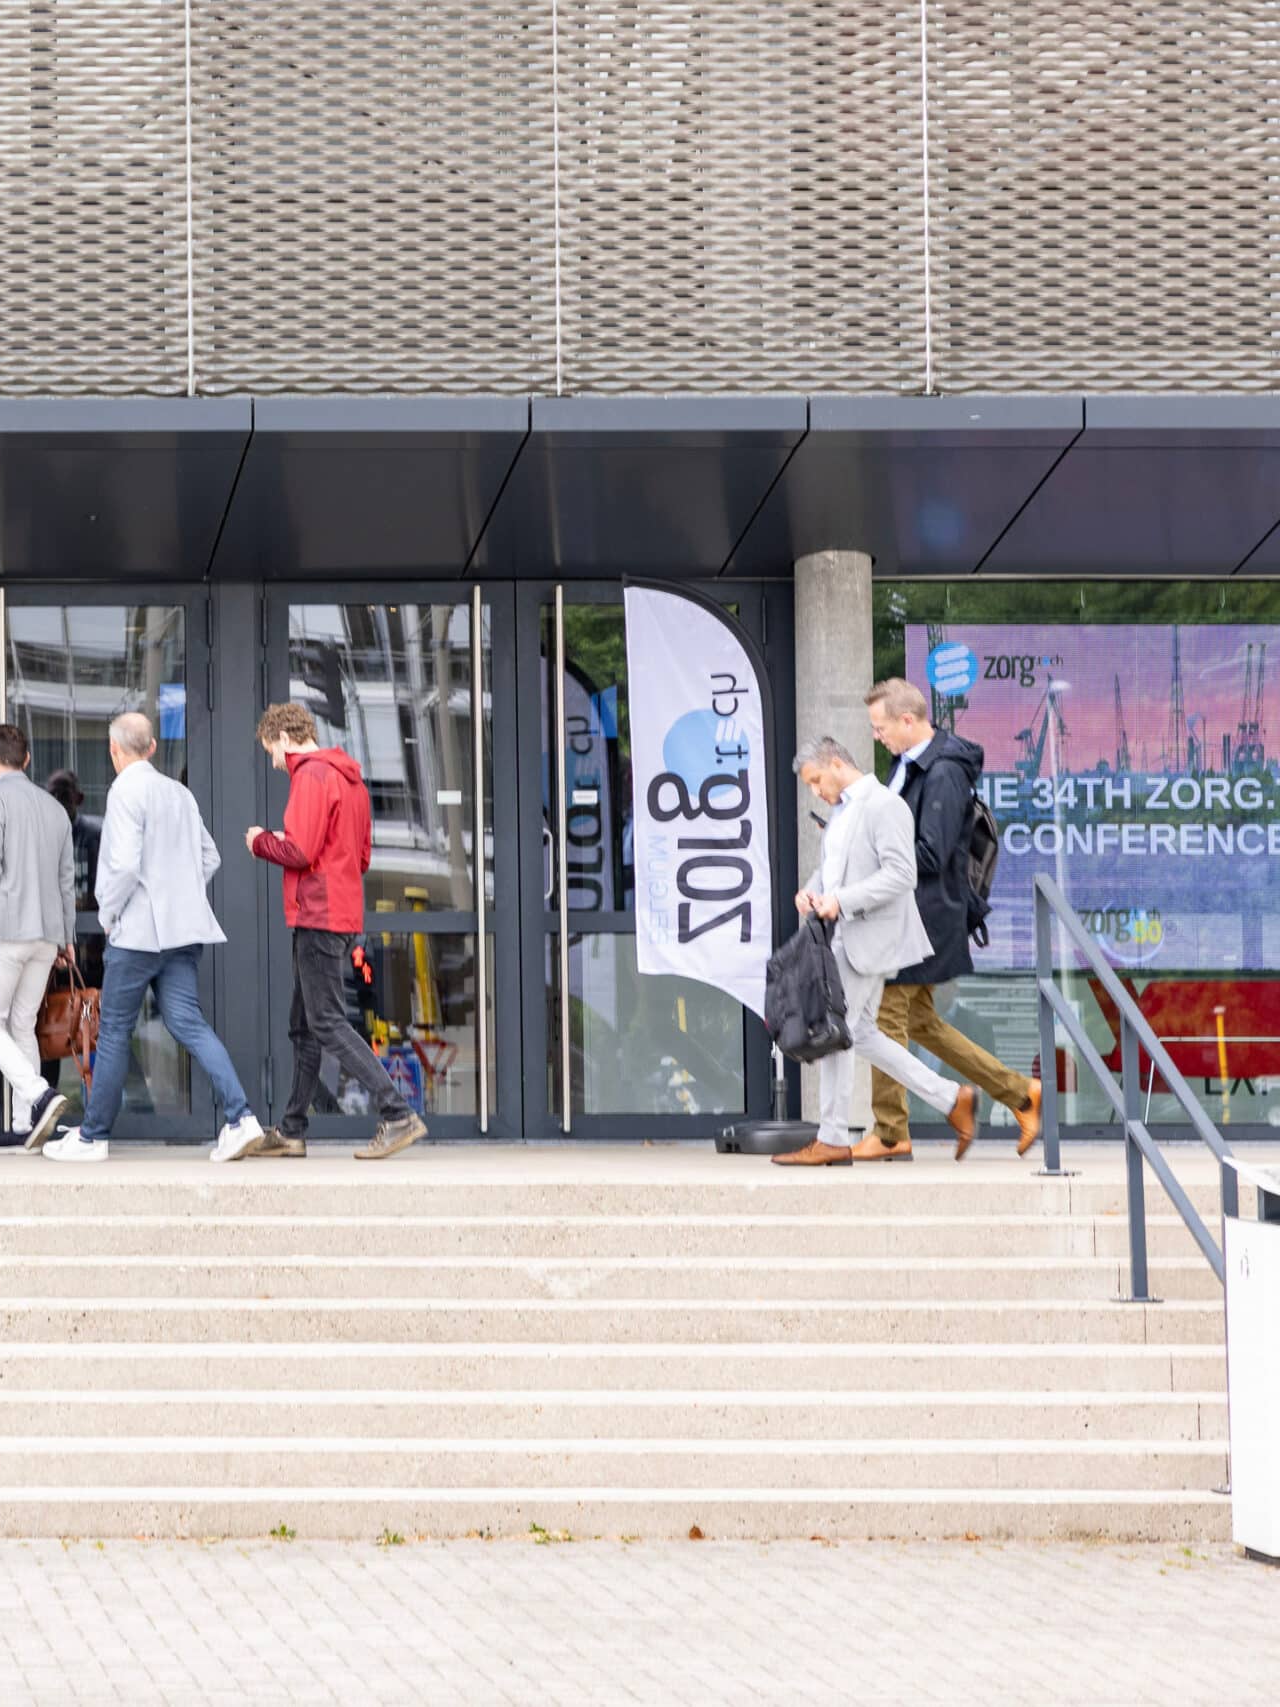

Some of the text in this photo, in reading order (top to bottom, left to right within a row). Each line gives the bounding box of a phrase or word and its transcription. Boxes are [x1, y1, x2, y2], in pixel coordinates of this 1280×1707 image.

[970, 776, 1280, 810] HE 34TH ZORG.
